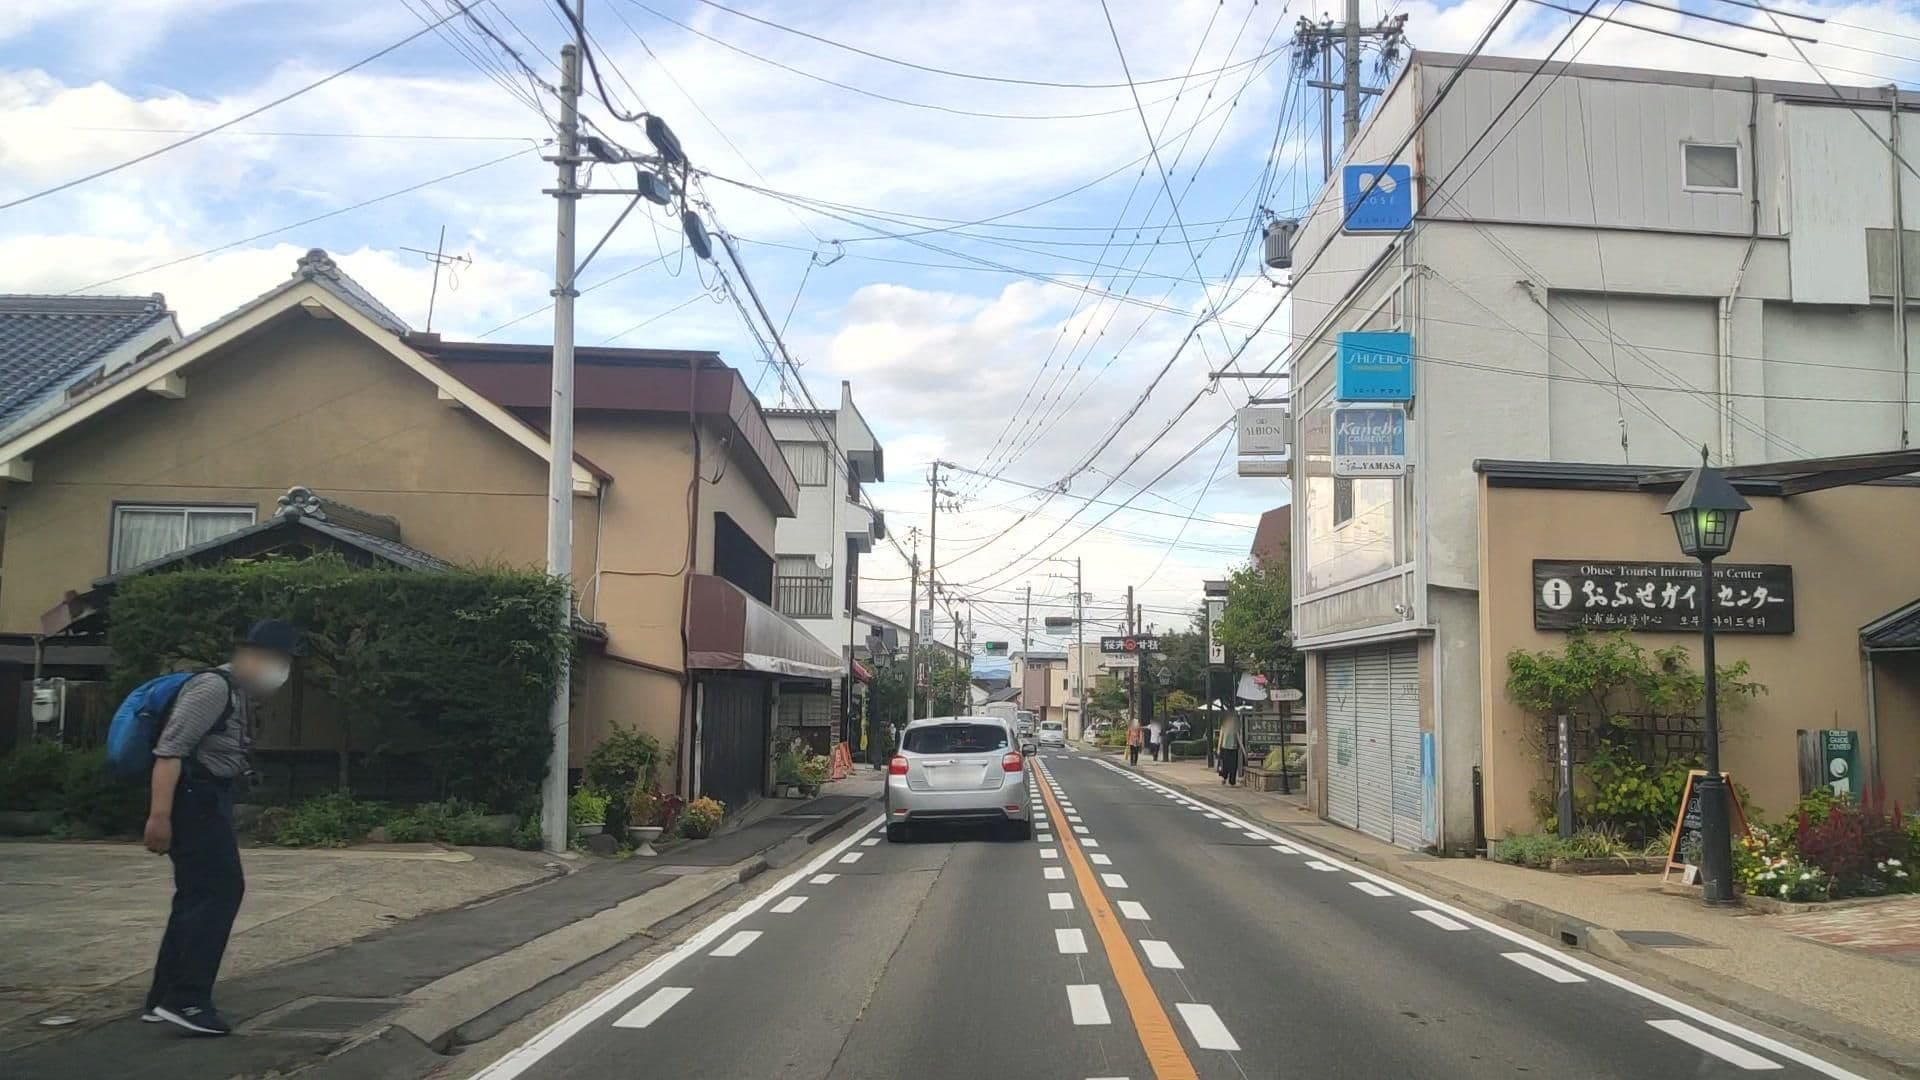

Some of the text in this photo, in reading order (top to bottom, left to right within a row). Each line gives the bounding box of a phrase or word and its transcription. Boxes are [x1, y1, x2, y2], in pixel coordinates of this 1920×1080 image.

[1345, 352, 1410, 365] SHISEIDO
[1246, 426, 1281, 435] ALBION
[1338, 421, 1403, 436] Kanebo
[1362, 462, 1402, 470] YAMASA
[1581, 565, 1763, 579] Obuse Tourist Informaon Center
[1582, 580, 1785, 610] おぶせガイセンター
[1679, 615, 1766, 629] 오부가이드센터
